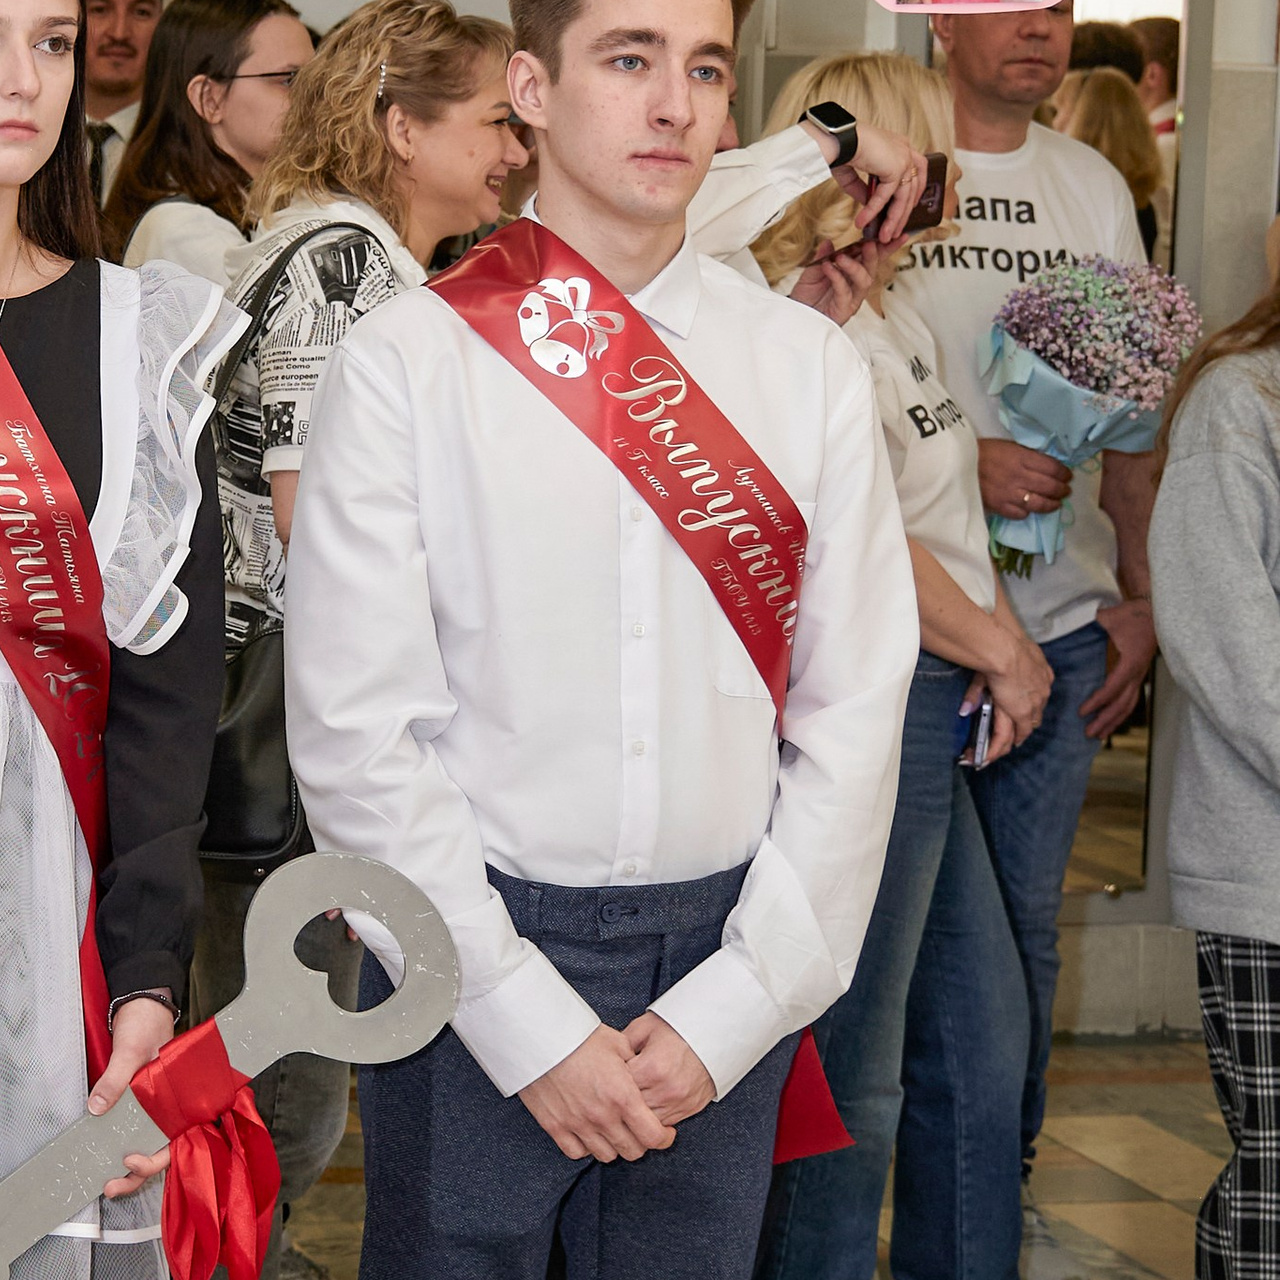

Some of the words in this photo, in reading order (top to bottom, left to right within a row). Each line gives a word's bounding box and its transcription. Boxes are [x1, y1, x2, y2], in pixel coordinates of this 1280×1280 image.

[954, 195, 1037, 224] апа
[896, 243, 1080, 283] иктори
[613, 436, 630, 448] 11
[638, 465, 669, 499] класс
[728, 459, 794, 535] Лучников
[601, 355, 798, 646] Выпускни
[50, 510, 86, 604] Татьяна
[710, 557, 751, 607] ГБОУ
